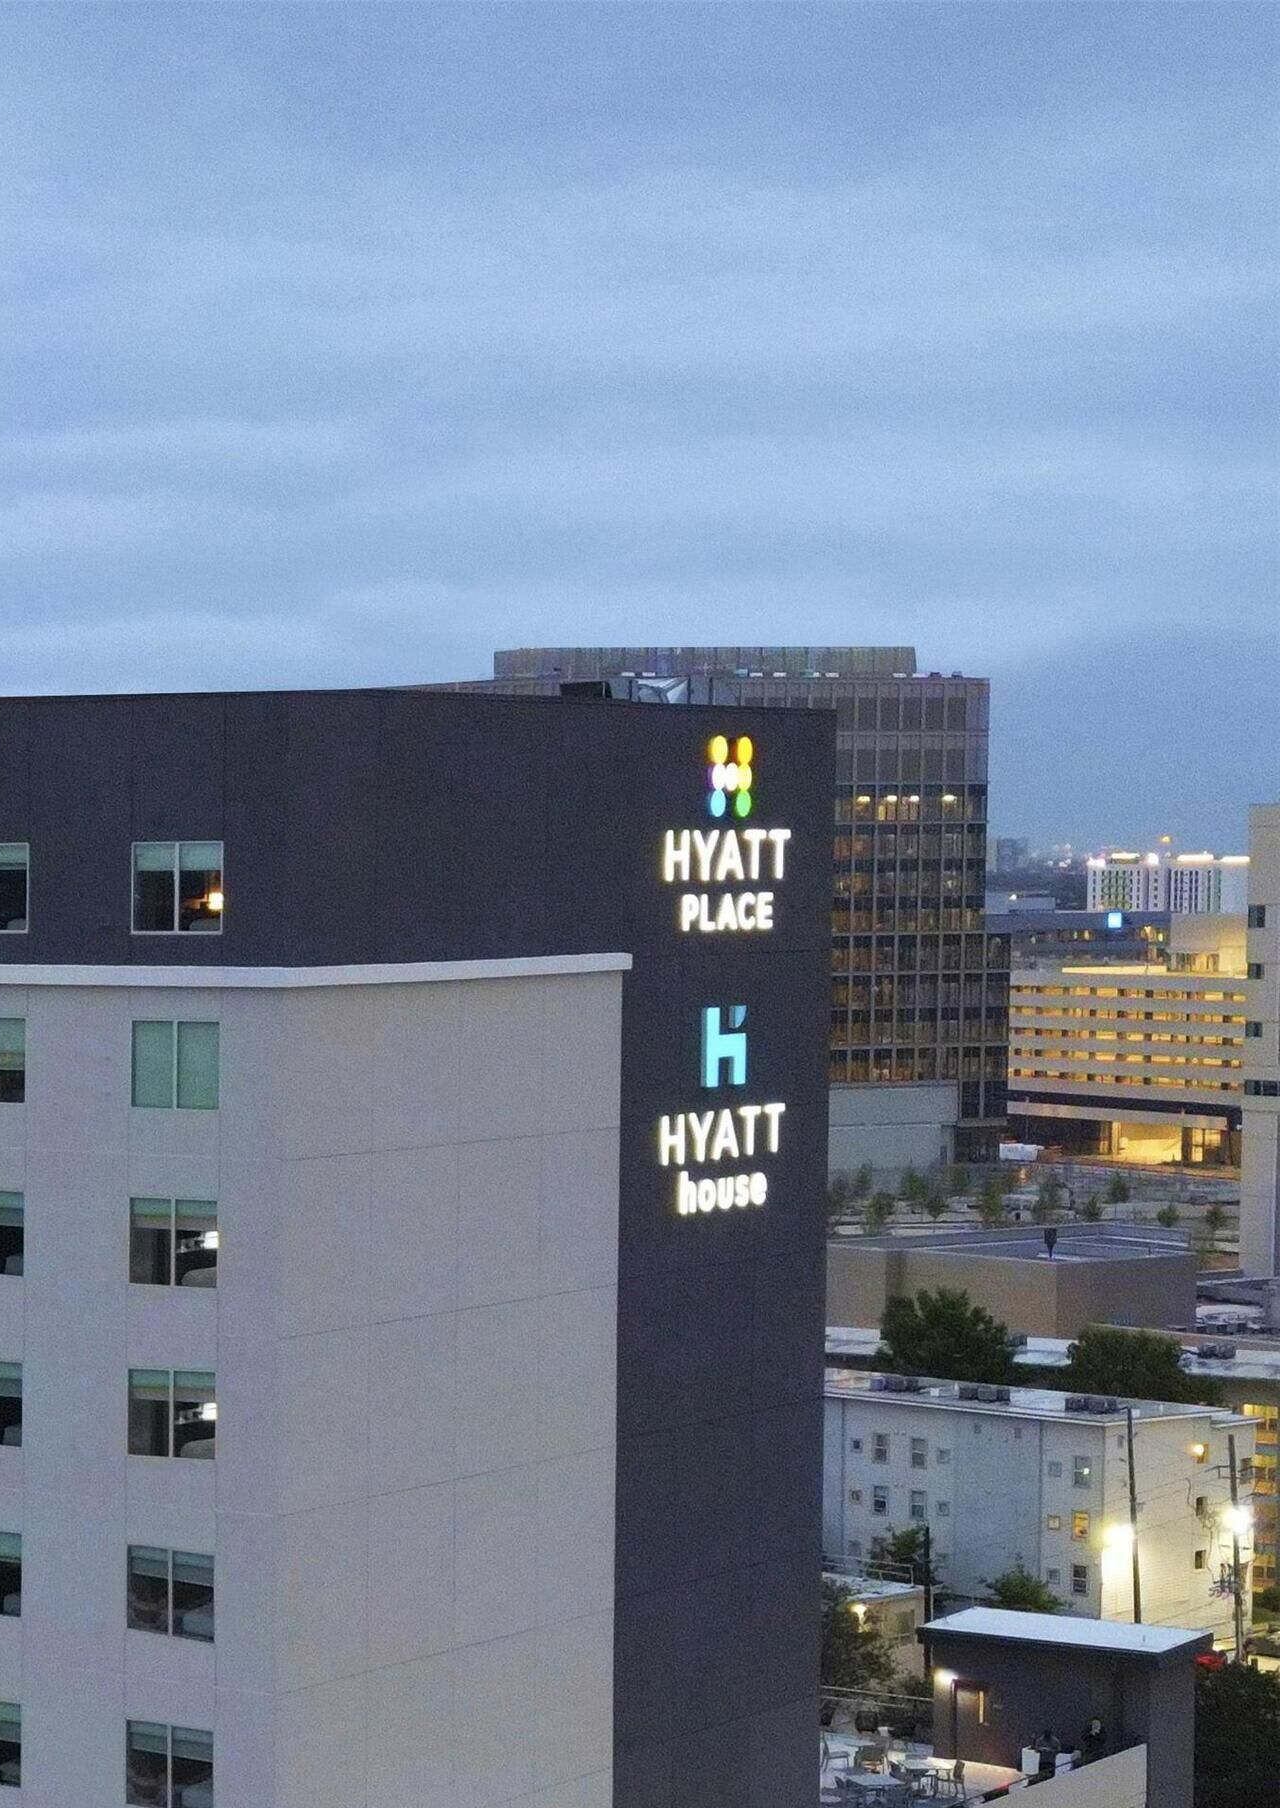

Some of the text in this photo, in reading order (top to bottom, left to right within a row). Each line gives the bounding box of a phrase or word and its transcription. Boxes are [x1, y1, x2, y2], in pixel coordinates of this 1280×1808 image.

[663, 828, 792, 882] HYATT
[680, 891, 774, 932] PLACE
[658, 1102, 786, 1166] HYATT
[677, 1170, 768, 1216] house
